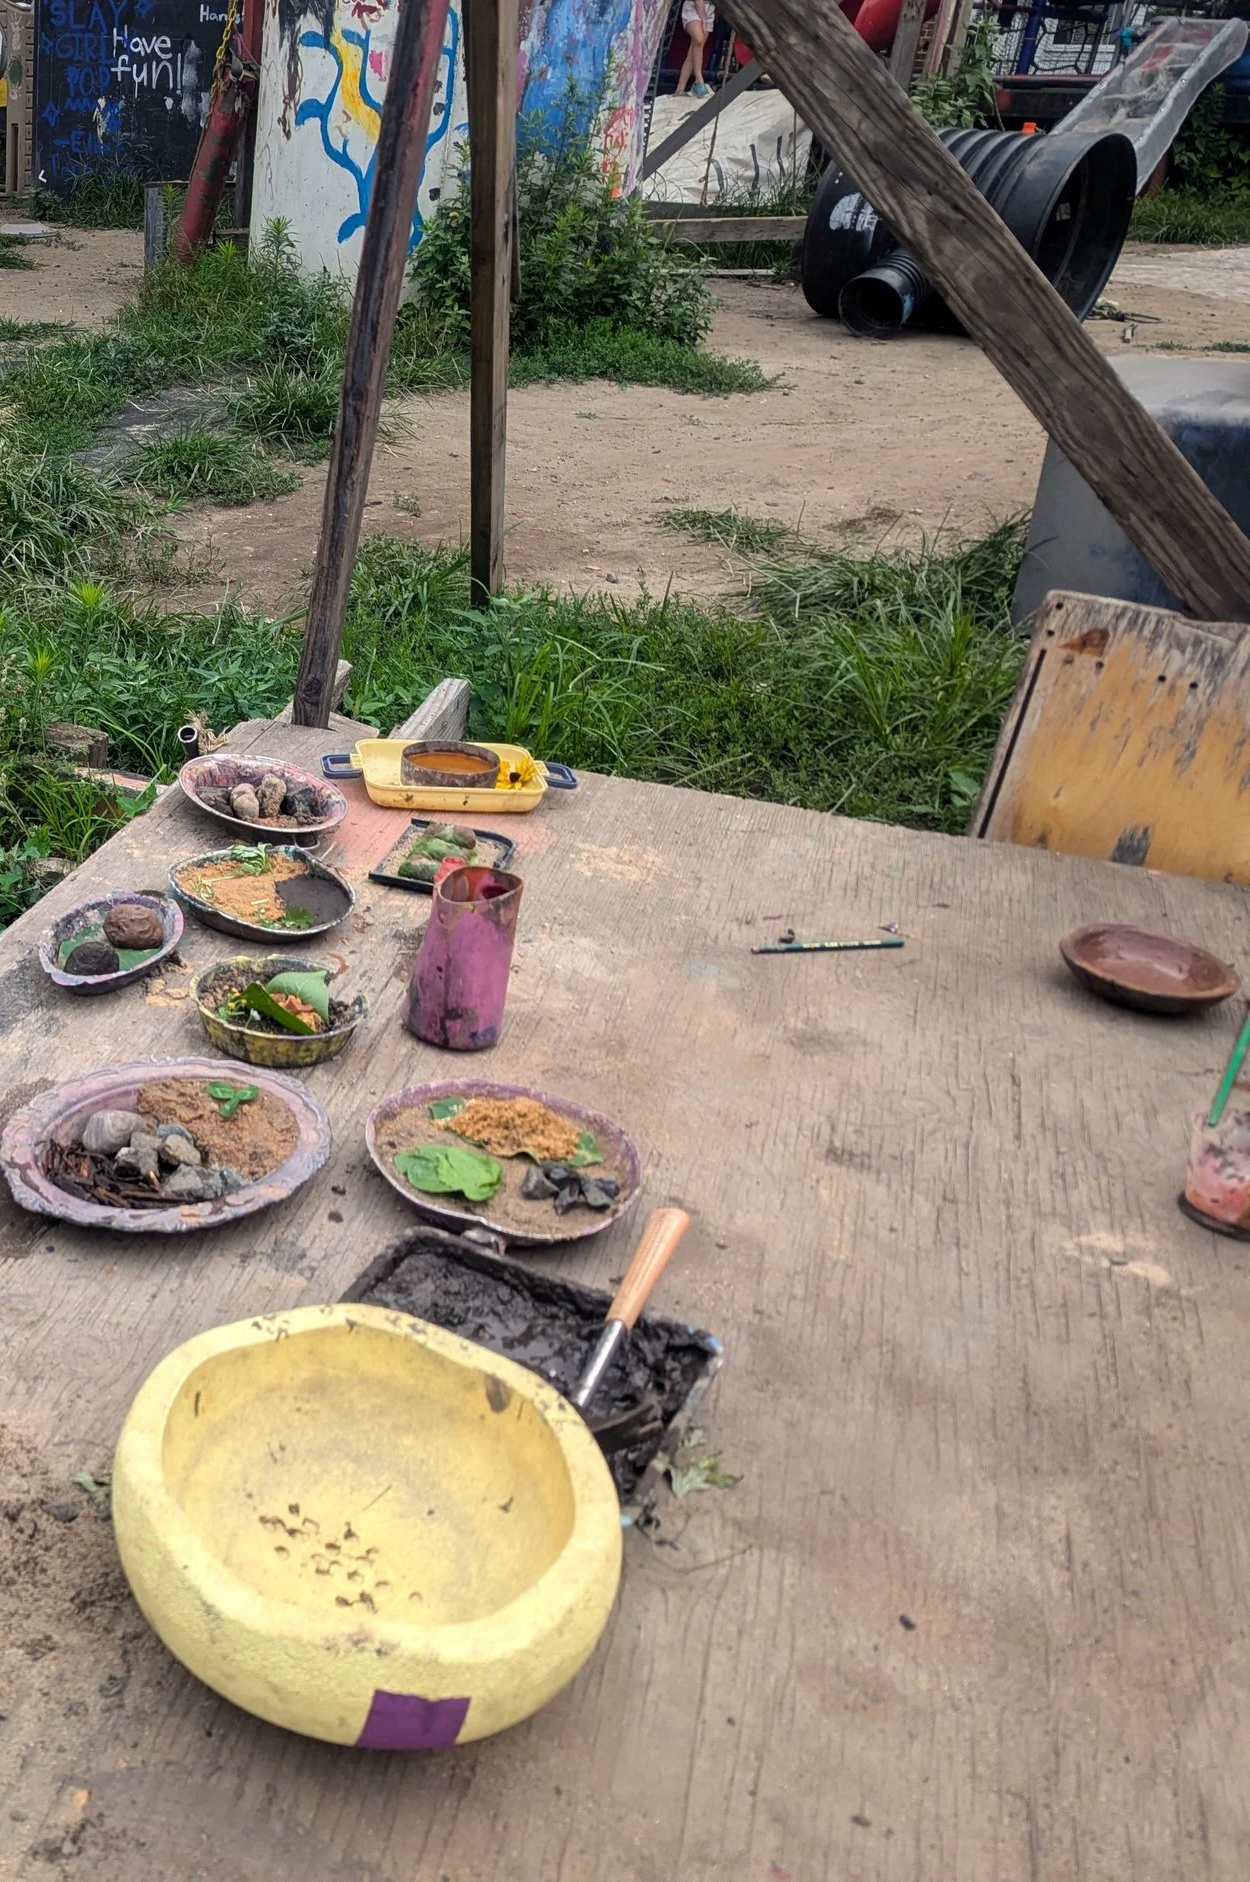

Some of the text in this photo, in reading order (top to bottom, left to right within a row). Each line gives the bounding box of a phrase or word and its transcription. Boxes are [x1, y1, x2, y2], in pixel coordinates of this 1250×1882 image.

[50, 0, 128, 33] SLAY
[199, 3, 241, 24] Hans
[55, 31, 114, 64] GIRL
[112, 24, 173, 59] Have
[66, 65, 110, 96] POP
[110, 54, 183, 96] fun!
